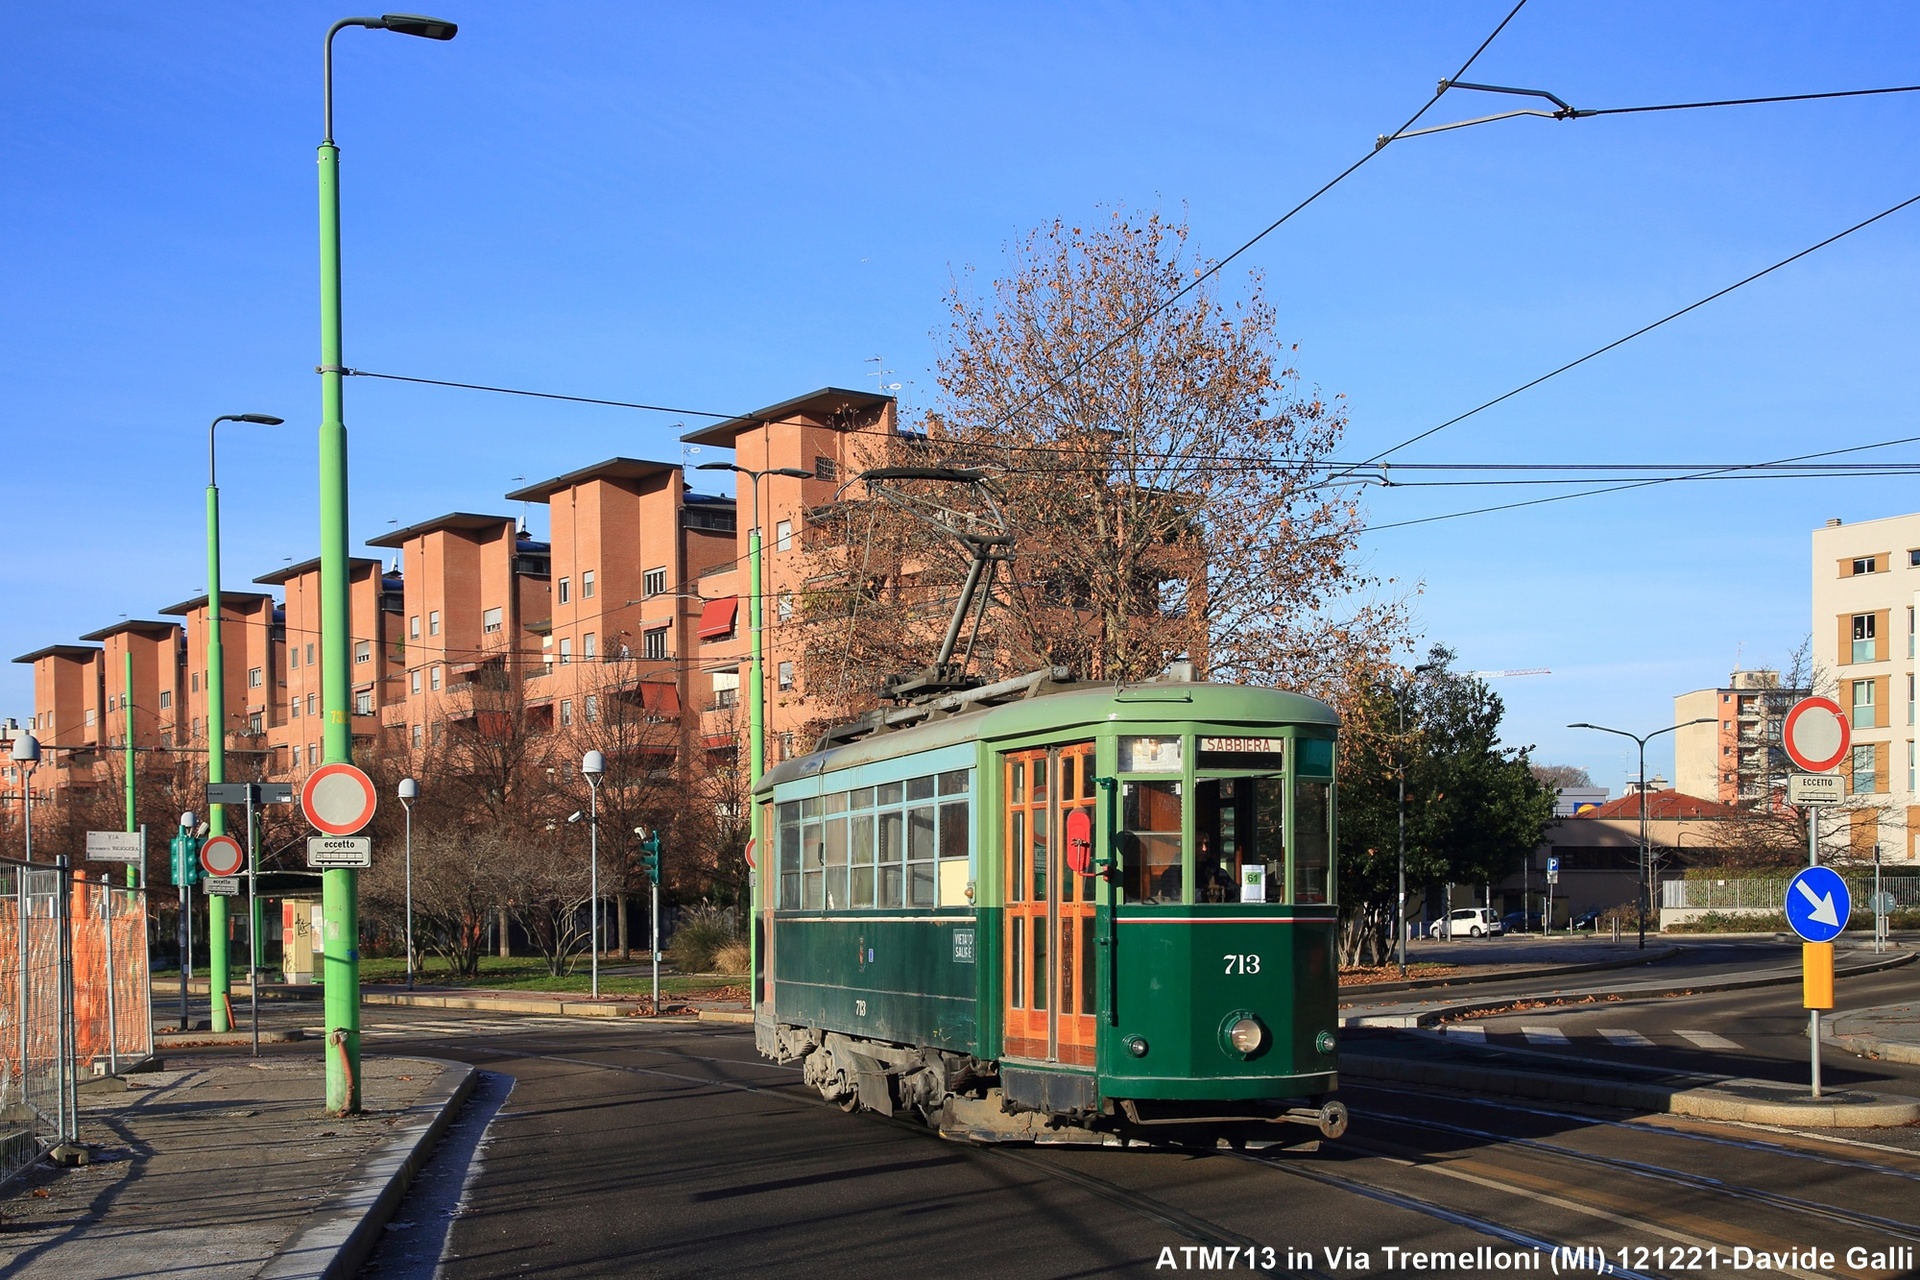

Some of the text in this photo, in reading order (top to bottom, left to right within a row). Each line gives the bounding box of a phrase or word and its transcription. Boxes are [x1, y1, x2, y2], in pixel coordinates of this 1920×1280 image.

[1207, 737, 1271, 752] SABBIERA
[1803, 779, 1833, 787] ECCETTO
[324, 840, 355, 848] eccetto
[1550, 859, 1557, 870] P
[1248, 874, 1258, 883] 61
[1223, 954, 1261, 975] 713
[856, 999, 867, 1017] 713
